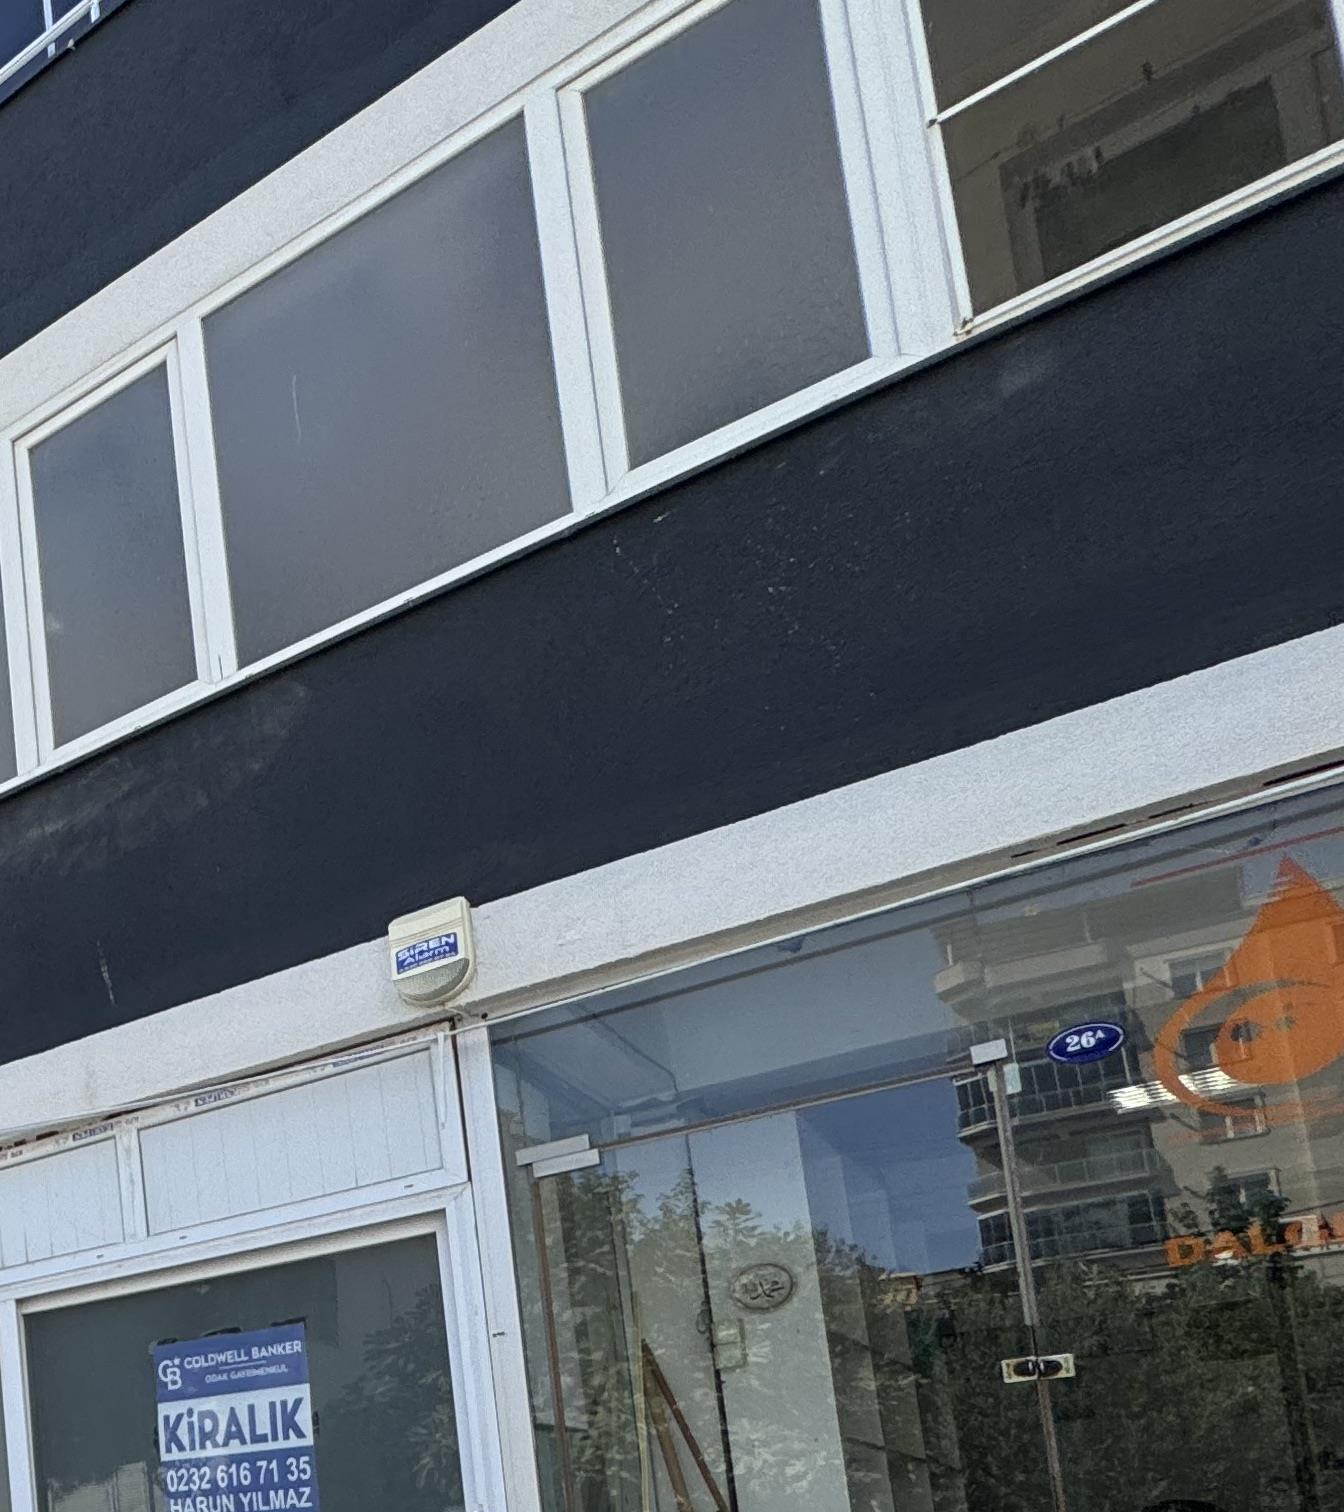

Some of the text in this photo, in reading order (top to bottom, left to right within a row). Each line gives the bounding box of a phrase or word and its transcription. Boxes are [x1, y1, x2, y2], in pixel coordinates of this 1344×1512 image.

[398, 934, 454, 961] SIREN
[403, 946, 449, 966] Alarm
[184, 1340, 302, 1369] COLDWELL BANKER
[167, 1456, 311, 1492] 0232 616 71 35
[239, 1487, 312, 1512] YILMAZ
